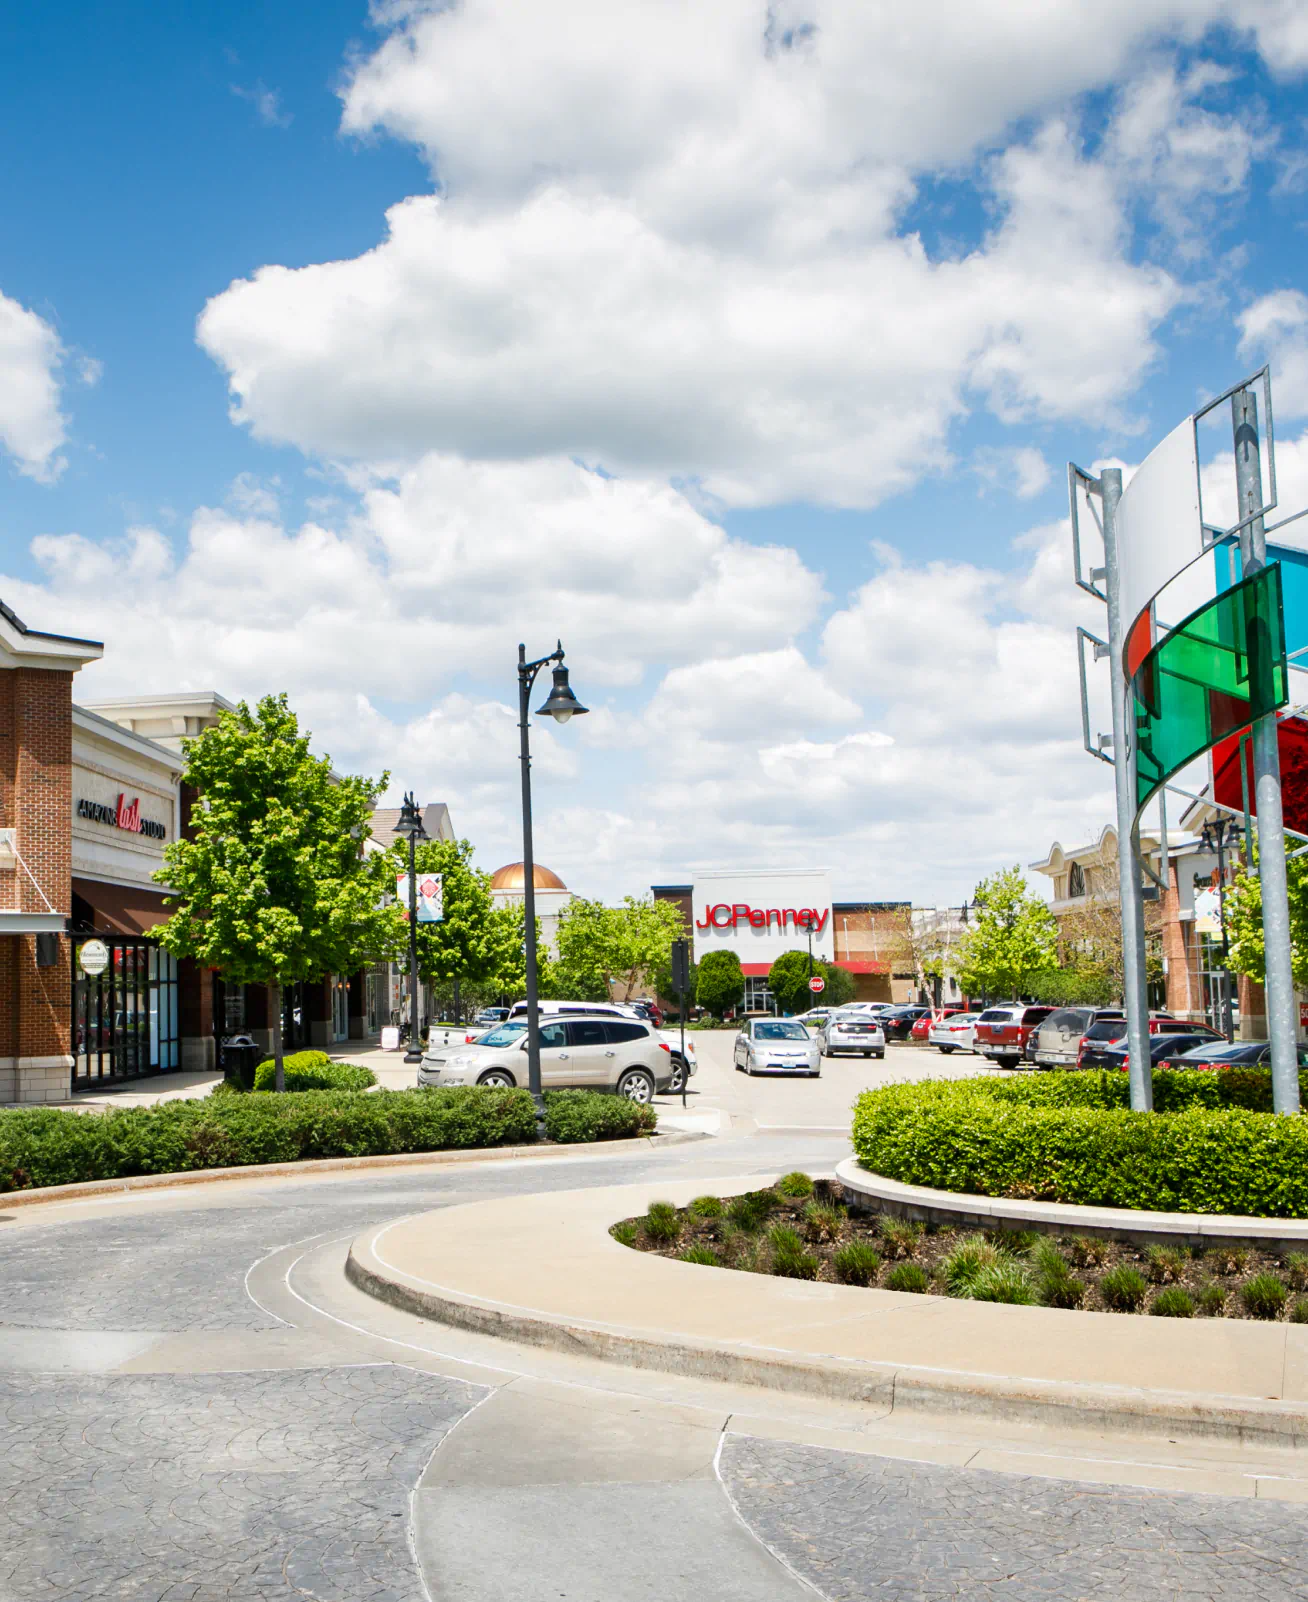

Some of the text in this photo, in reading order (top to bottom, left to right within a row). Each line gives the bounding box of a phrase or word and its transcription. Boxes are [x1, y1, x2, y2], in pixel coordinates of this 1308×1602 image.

[77, 793, 166, 840] AMAZING lash STUDIO
[696, 903, 829, 933] JCPenney
